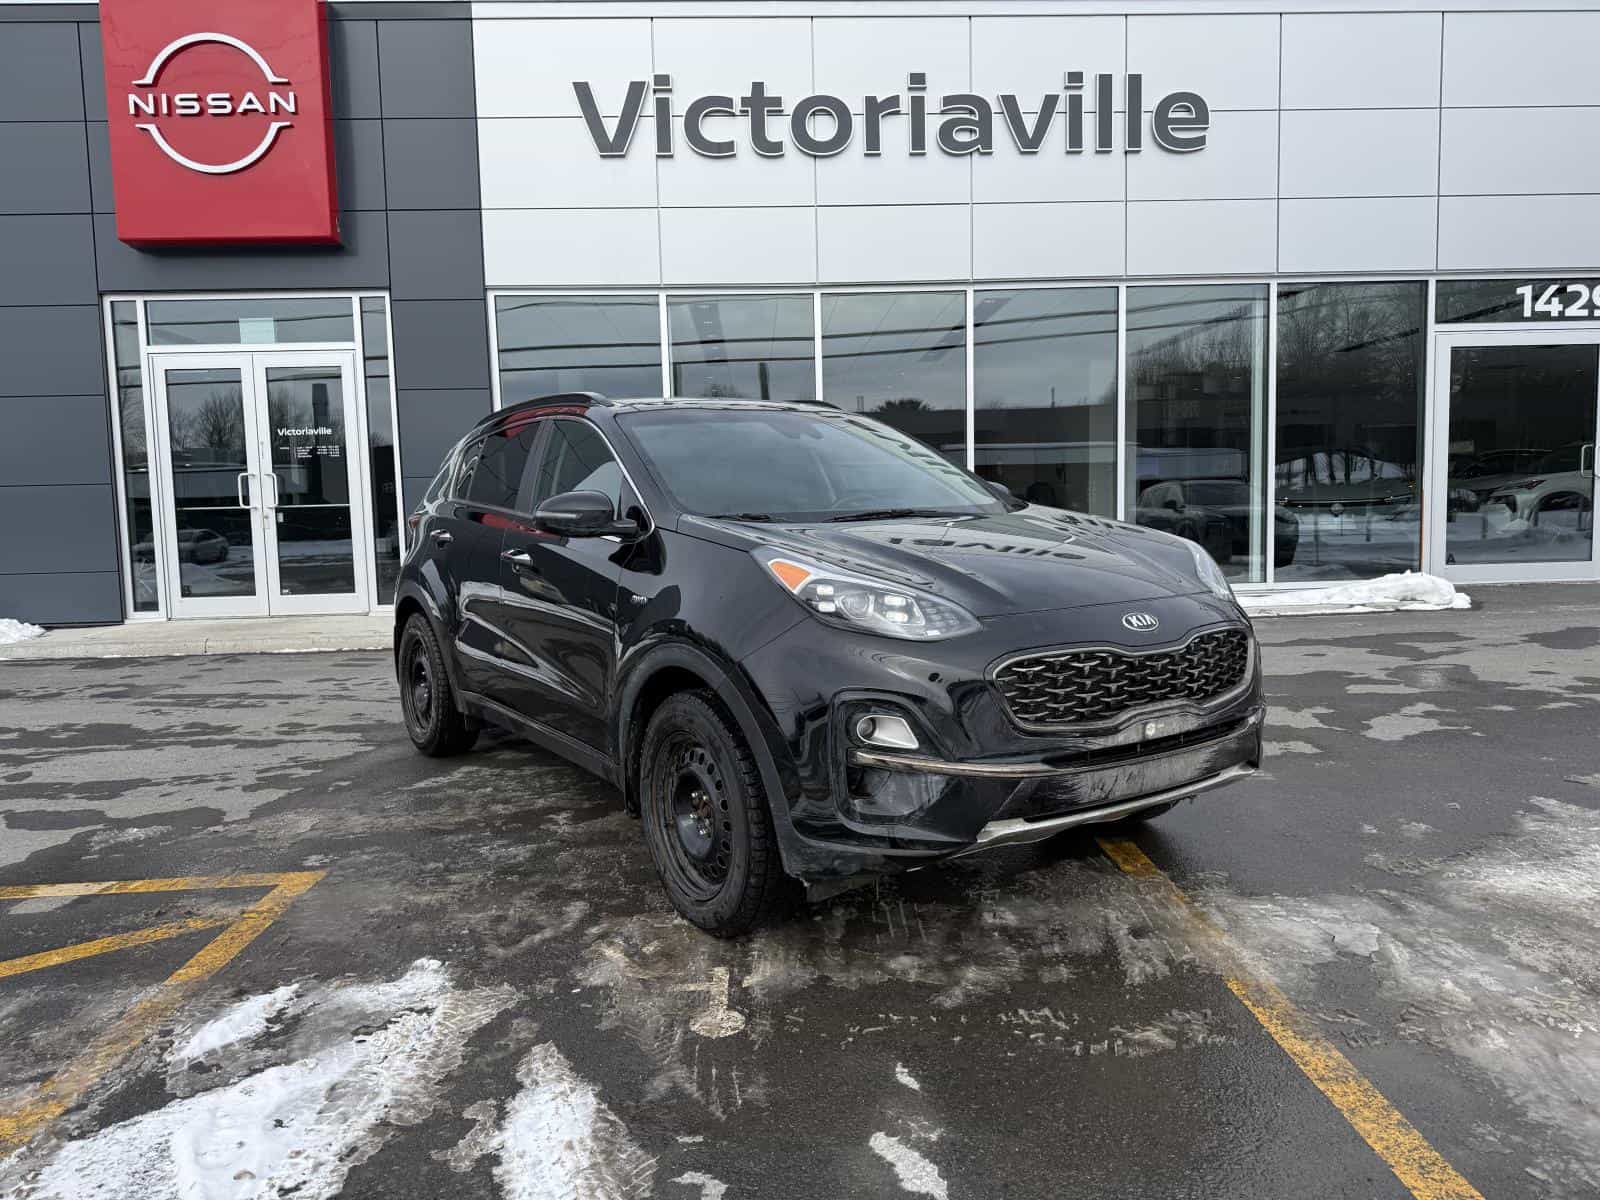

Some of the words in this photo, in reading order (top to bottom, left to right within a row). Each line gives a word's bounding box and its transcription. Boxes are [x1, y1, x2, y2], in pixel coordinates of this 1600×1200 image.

[128, 91, 297, 115] NISSAN
[572, 72, 1210, 158] Victoriaville
[277, 426, 333, 437] Victoriaville
[1127, 614, 1157, 627] KIA
